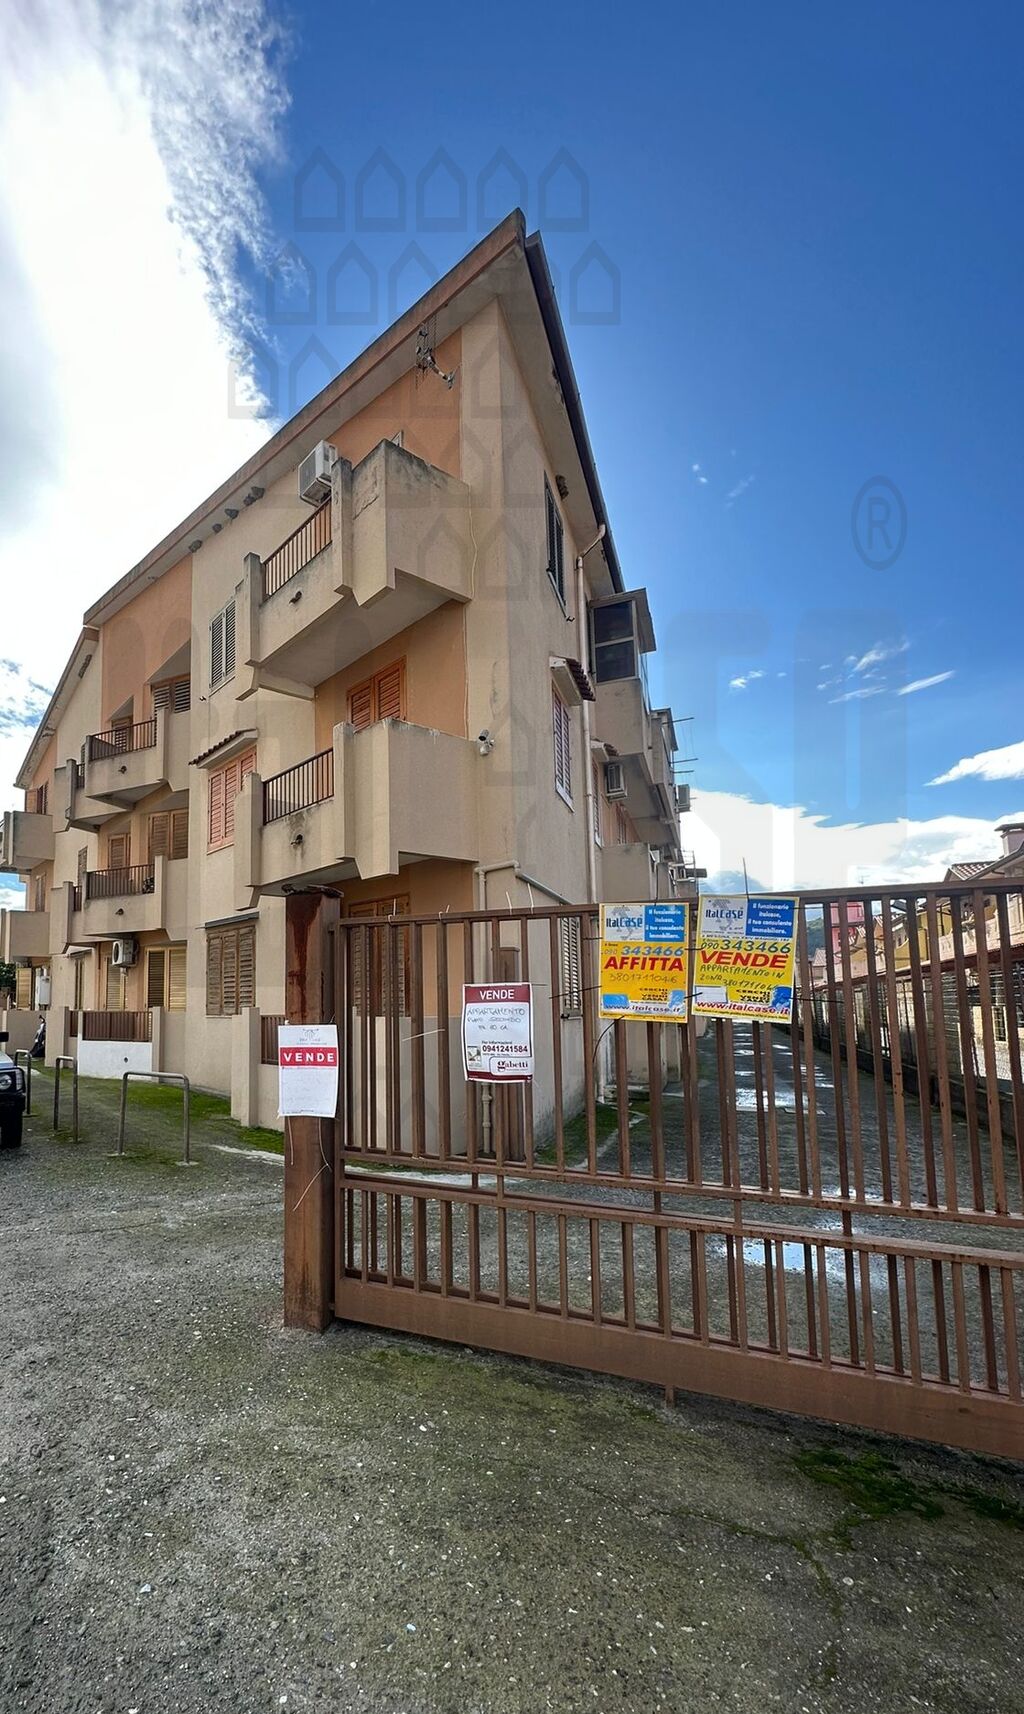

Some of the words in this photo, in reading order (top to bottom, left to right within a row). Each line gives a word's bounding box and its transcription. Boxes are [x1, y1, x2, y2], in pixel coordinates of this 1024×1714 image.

[621, 946, 684, 956] 343466
[720, 940, 790, 954] 343466
[604, 956, 684, 971] AFFITTA
[700, 950, 788, 968] VENDE
[700, 964, 770, 976] APPARTAMENTO
[480, 989, 515, 1000] VENDE
[283, 1052, 335, 1062] VENDE
[497, 1060, 528, 1072] gabetti
